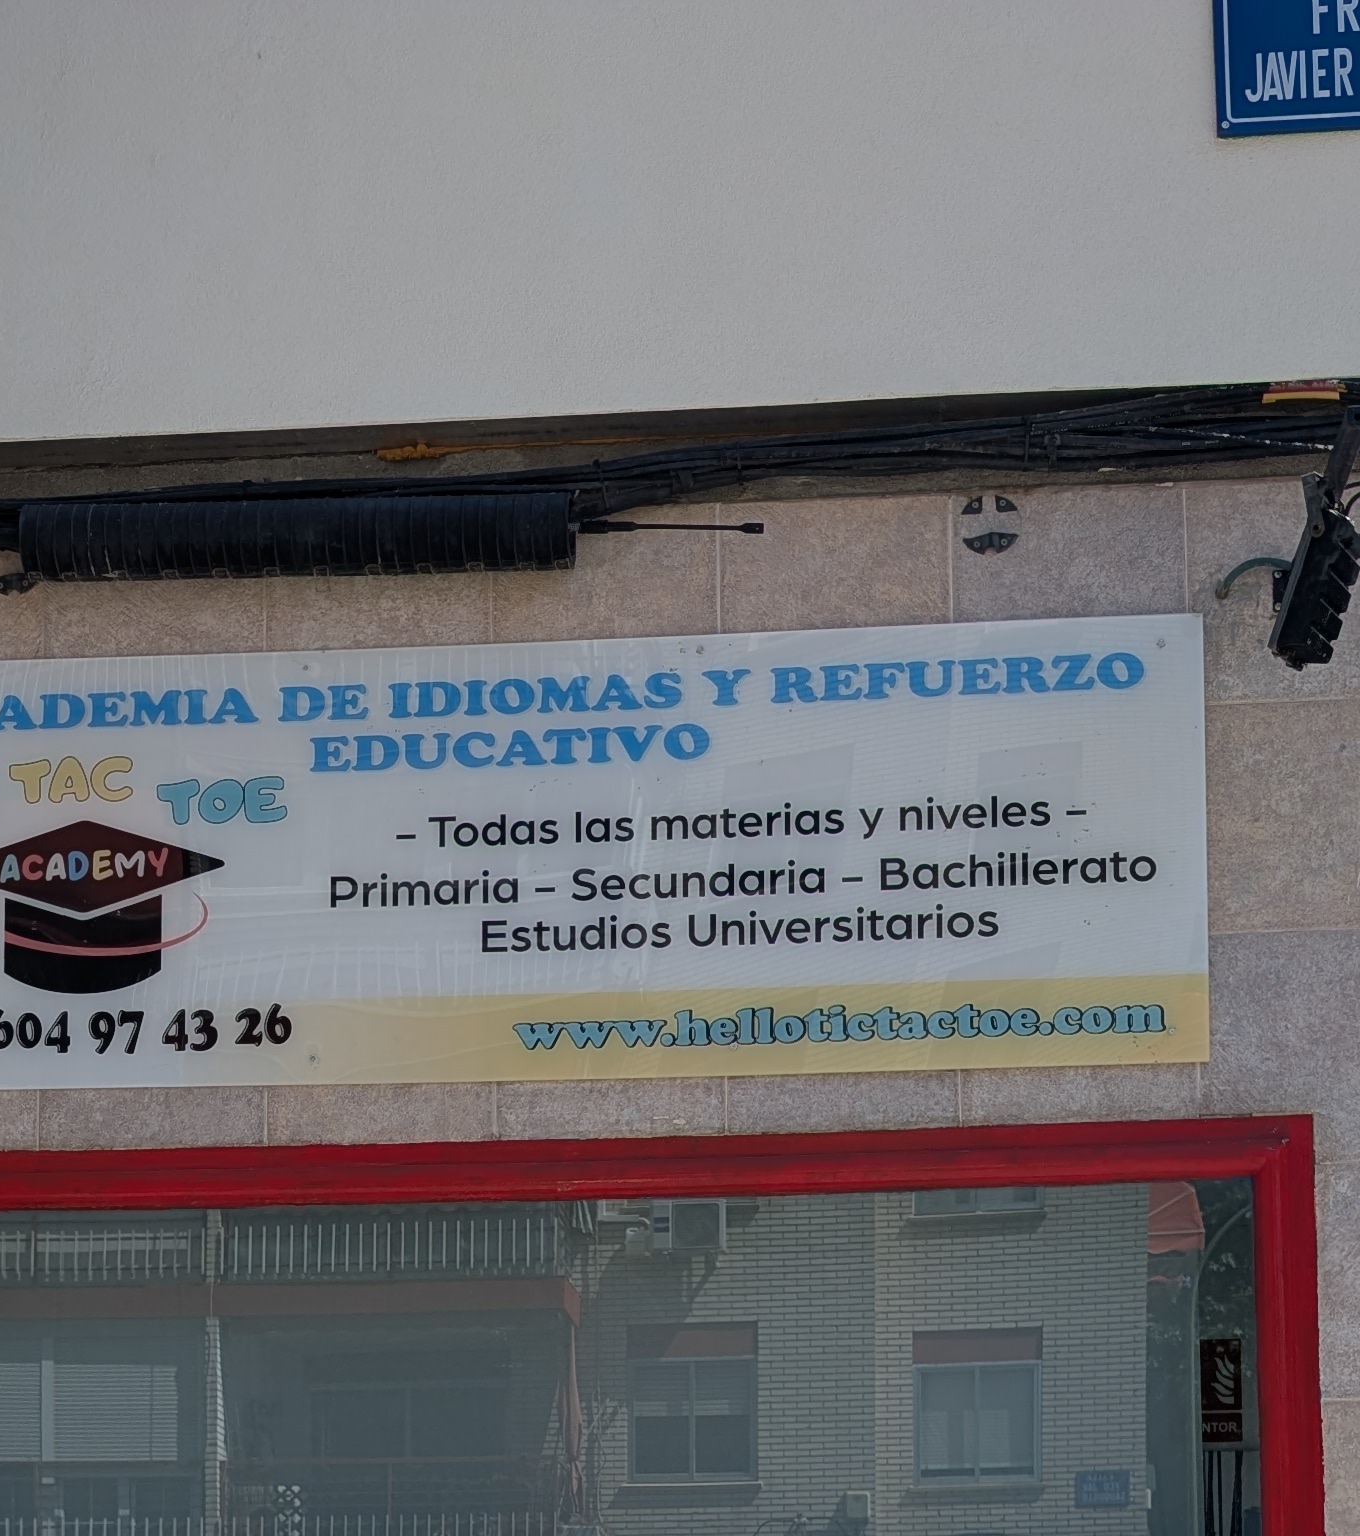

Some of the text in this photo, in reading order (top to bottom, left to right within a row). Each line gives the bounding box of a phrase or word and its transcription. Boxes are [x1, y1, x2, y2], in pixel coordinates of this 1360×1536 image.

[1245, 47, 1354, 103] JAVIER
[278, 683, 369, 724] DE
[388, 668, 683, 720] IDIOMAS
[701, 667, 753, 708] Y
[770, 652, 1145, 706] REFUERZO
[309, 722, 711, 773] EDUCATIVO
[9, 755, 134, 804] TAC
[157, 775, 289, 825] TOE
[427, 813, 560, 848] Todas
[573, 811, 634, 843] las
[650, 802, 845, 840] materias
[858, 806, 884, 839] y
[899, 797, 1051, 832] niveles
[0, 847, 169, 883] ACADEMY
[329, 873, 520, 910] Primaria
[570, 859, 827, 902] Secundaria
[879, 852, 1158, 891] Bachillerato
[480, 904, 999, 954] Estudios Universitarios
[88, 1008, 144, 1054] 97
[161, 1008, 219, 1052] 43
[235, 1003, 293, 1046] 26
[512, 1001, 1166, 1050] www.hellotictactoe.com
